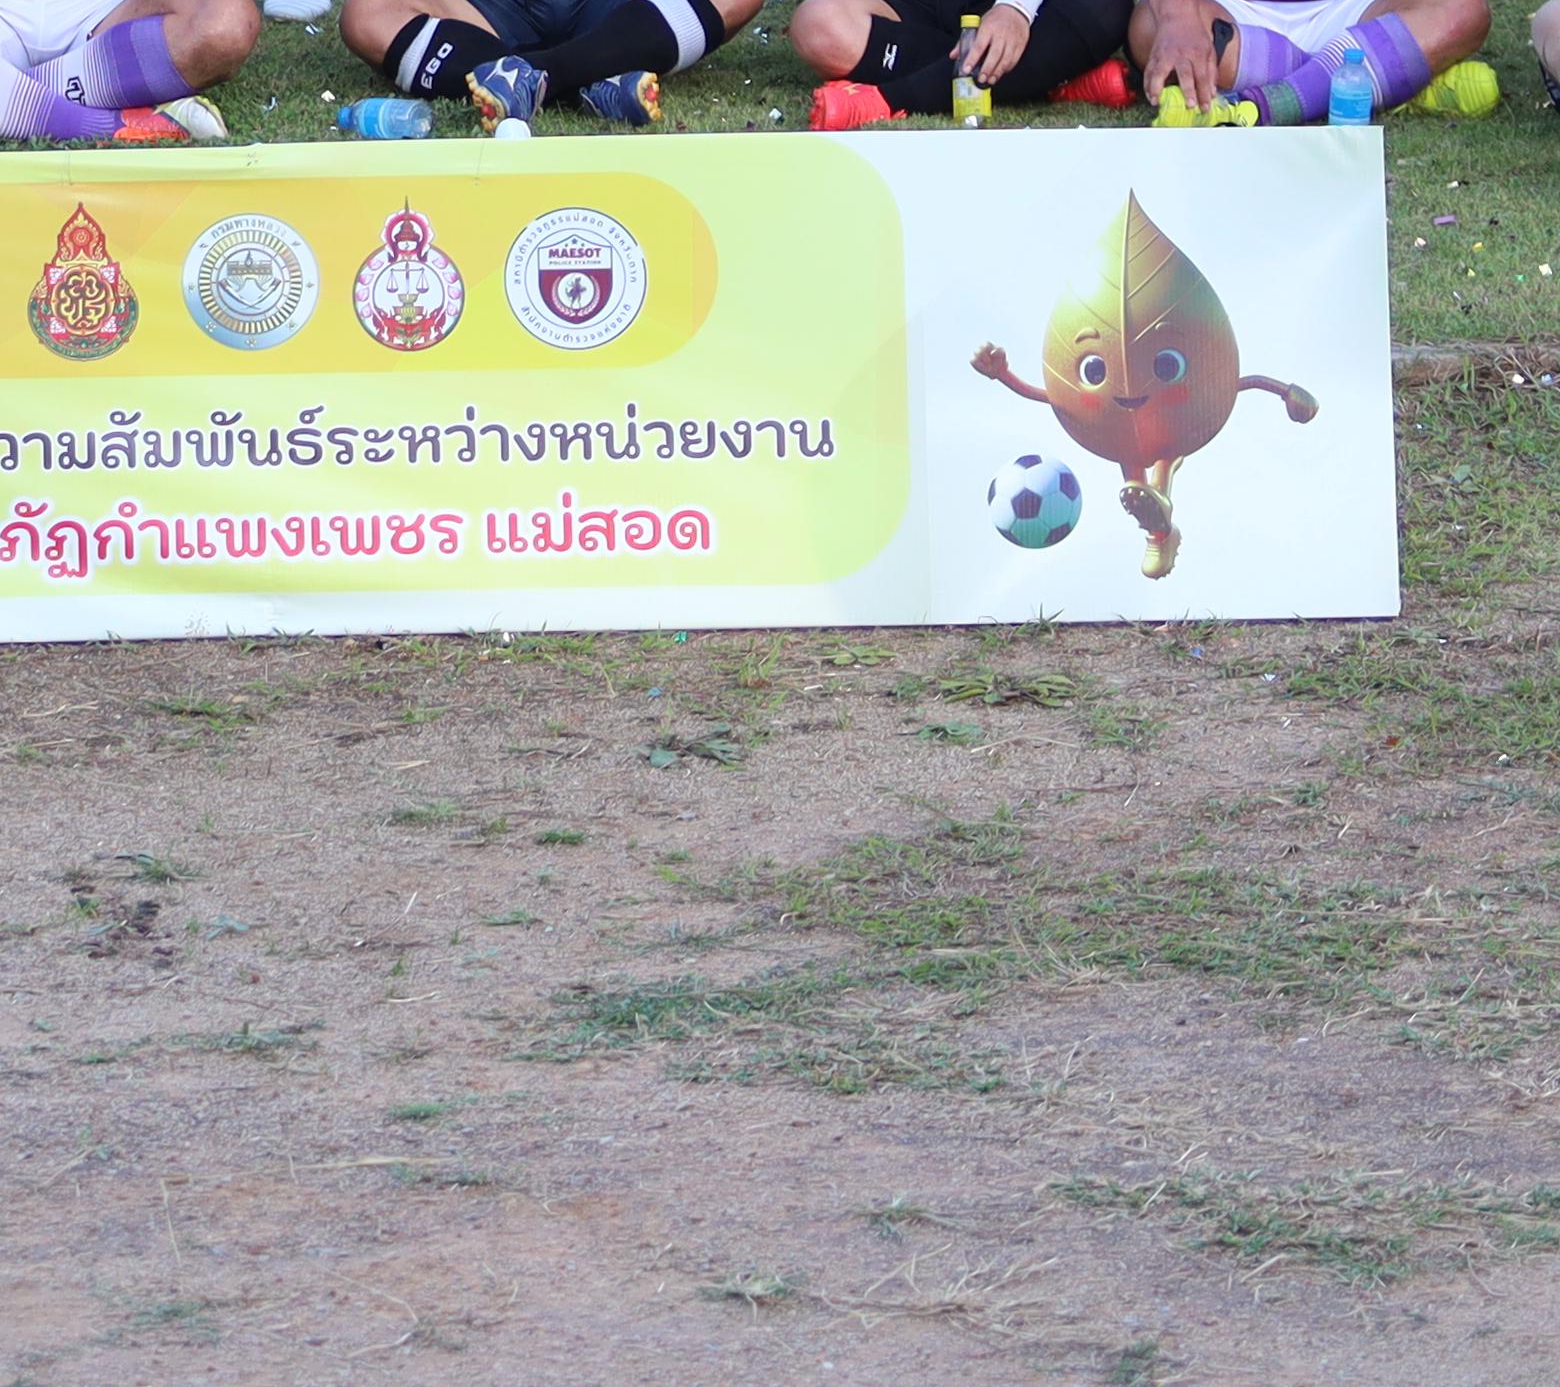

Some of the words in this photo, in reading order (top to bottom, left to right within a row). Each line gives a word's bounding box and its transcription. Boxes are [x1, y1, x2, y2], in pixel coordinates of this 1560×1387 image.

[419, 40, 455, 91] EGO
[547, 247, 602, 259] MAESOT
[484, 491, 712, 555] แม่สอด
